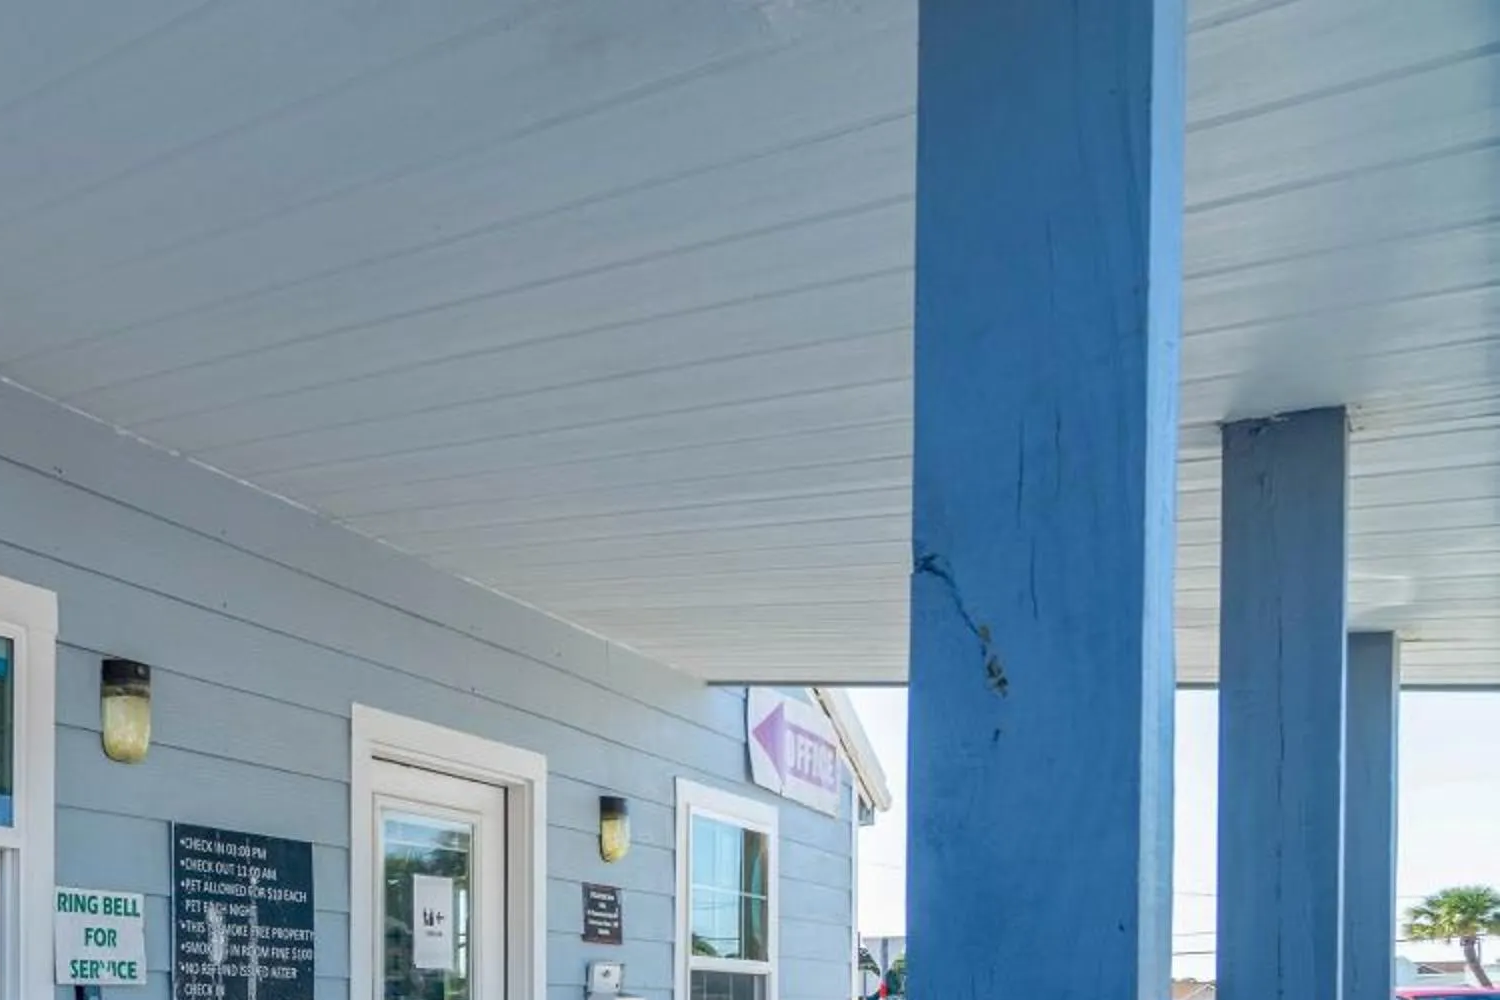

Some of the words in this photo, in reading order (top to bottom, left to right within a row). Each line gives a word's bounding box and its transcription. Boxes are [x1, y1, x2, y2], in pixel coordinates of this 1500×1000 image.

[185, 836, 213, 854] CHECK
[252, 847, 267, 861] PM
[185, 858, 213, 873] CHECK
[215, 861, 235, 876] OUT
[262, 867, 278, 881] AM
[186, 878, 202, 892] PET
[203, 880, 246, 898] ALLOWED
[284, 889, 307, 904] EACH
[57, 891, 99, 915] RING
[103, 895, 141, 918] BELL
[185, 898, 201, 913] PET
[84, 926, 117, 948] FOR
[186, 919, 206, 934] THIS
[185, 962, 200, 975] NO
[239, 965, 269, 979] ISSED
[183, 983, 213, 997] CHECK
